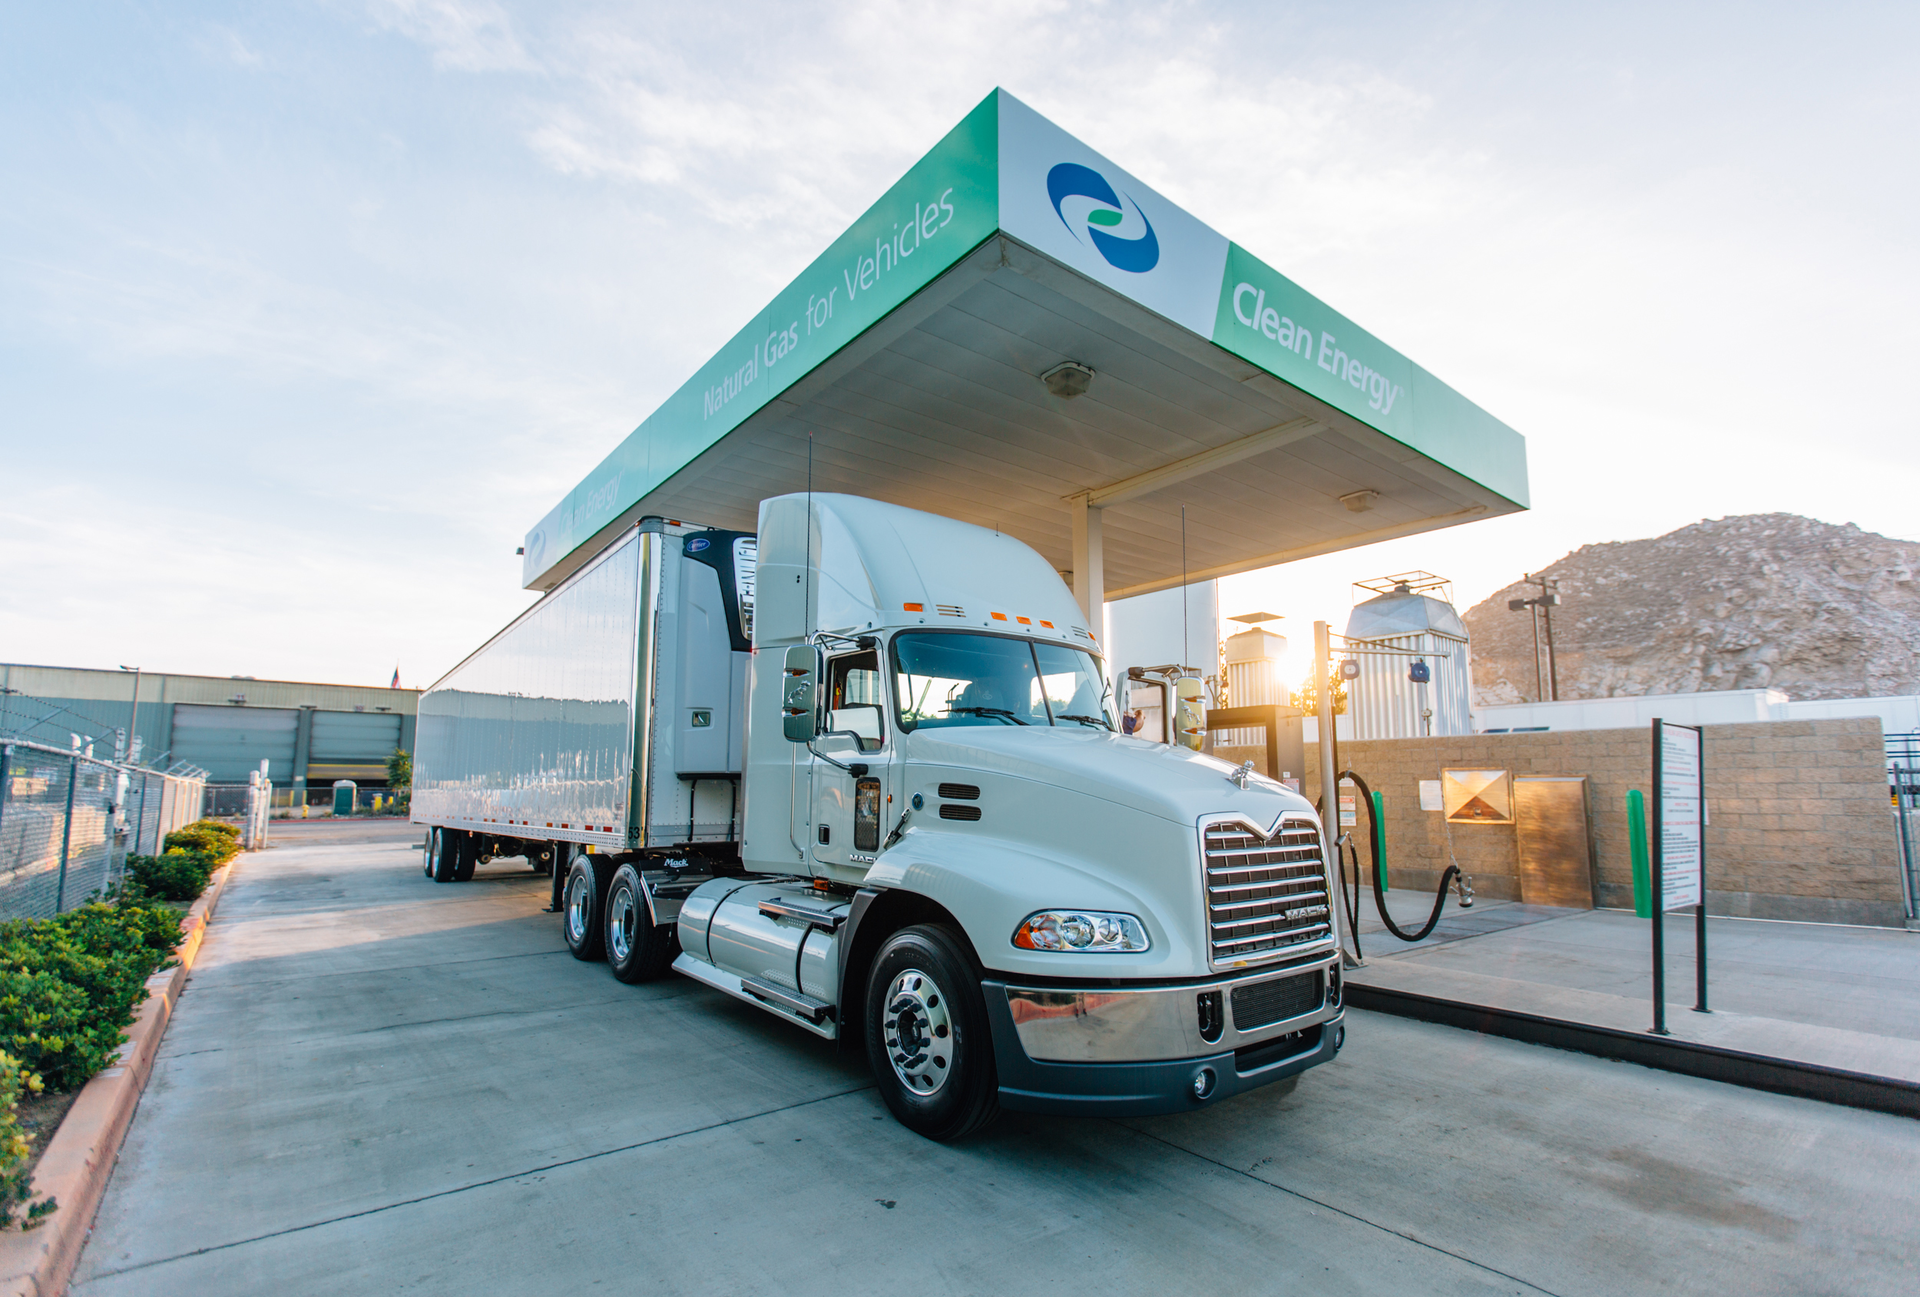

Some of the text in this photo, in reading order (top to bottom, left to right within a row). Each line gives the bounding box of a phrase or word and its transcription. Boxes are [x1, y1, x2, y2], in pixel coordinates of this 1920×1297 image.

[704, 187, 954, 421] Natural Gas for Vehicles
[1233, 282, 1399, 416] Clean Energy
[560, 470, 622, 539] Clean Energy
[664, 858, 688, 868] Mack
[1285, 904, 1327, 920] MACK
